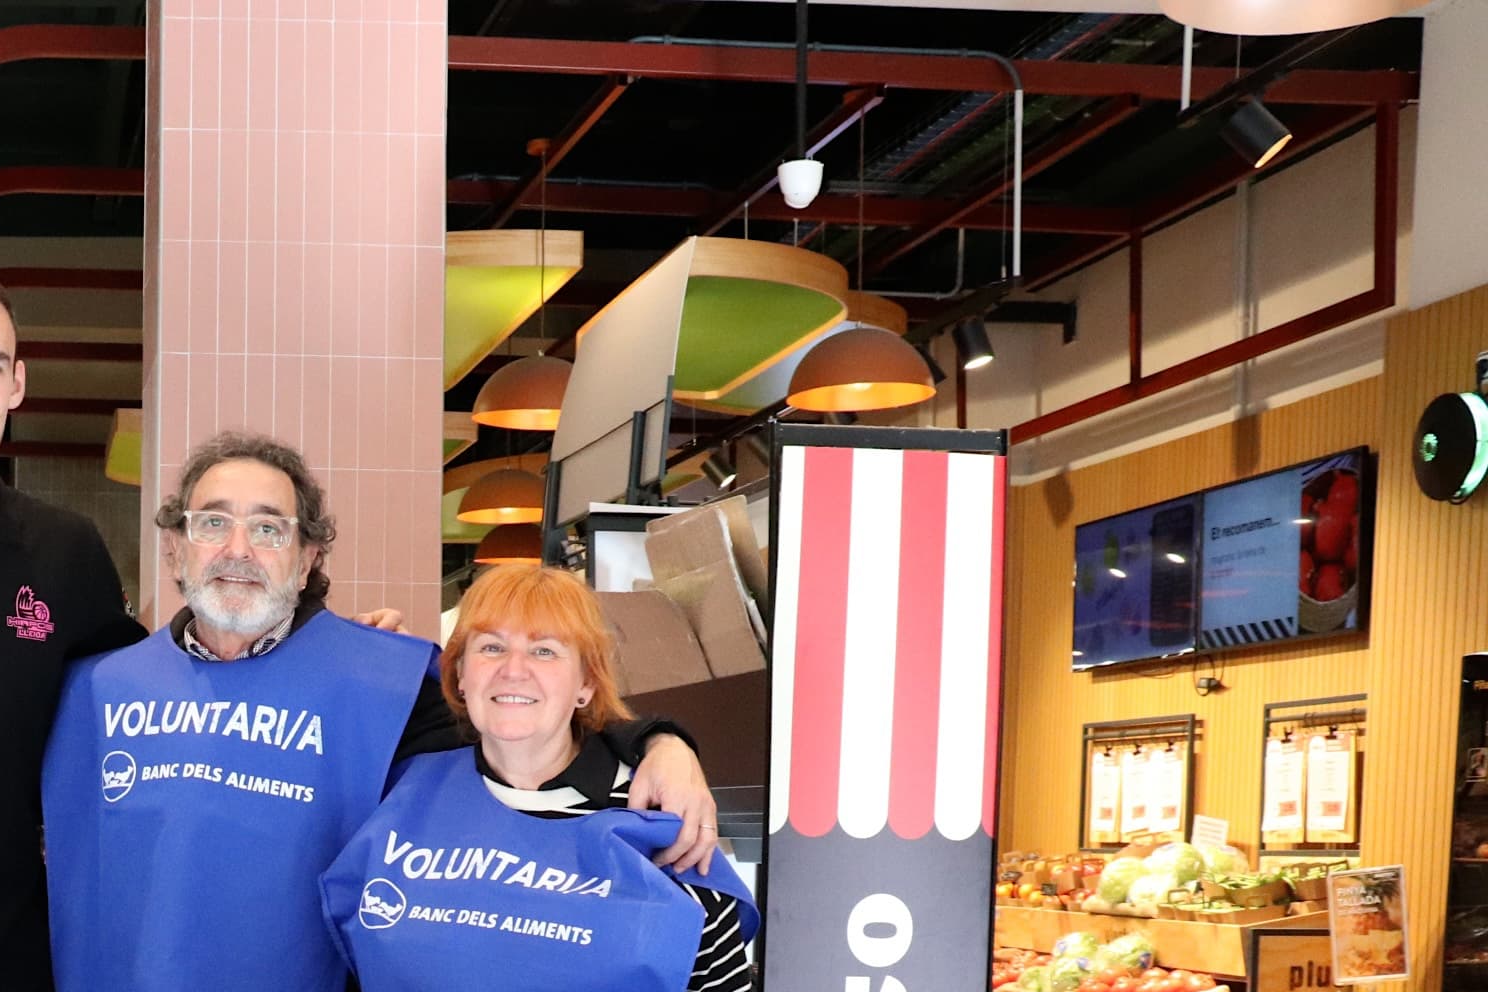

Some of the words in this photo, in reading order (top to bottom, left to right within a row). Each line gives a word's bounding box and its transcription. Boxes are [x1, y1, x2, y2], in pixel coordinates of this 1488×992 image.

[104, 700, 324, 755] VOLUNTARI/A
[141, 763, 180, 781] BANC
[182, 763, 223, 782] DELS
[225, 772, 315, 803] ALIMENTS
[383, 830, 612, 898] VOLUNTARI/A
[408, 906, 452, 923] BANC
[456, 909, 498, 929] DELS
[500, 916, 593, 945] ALIMENTS
